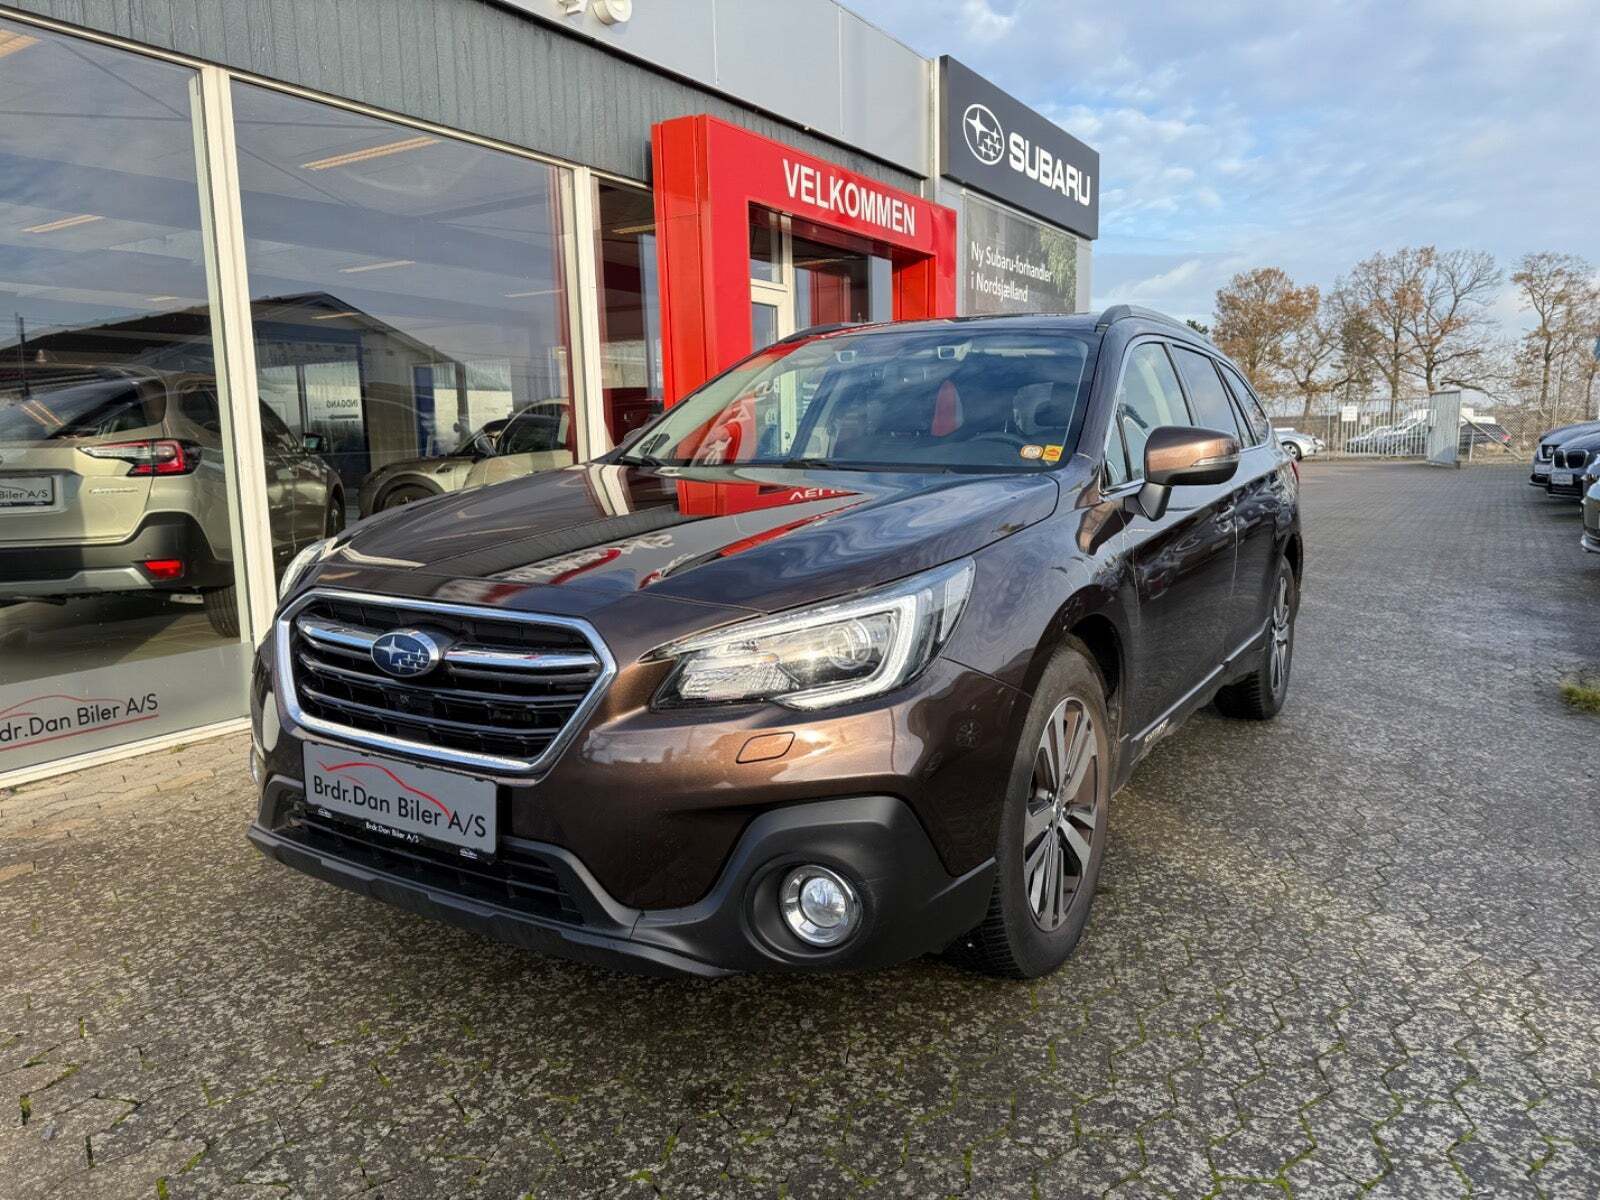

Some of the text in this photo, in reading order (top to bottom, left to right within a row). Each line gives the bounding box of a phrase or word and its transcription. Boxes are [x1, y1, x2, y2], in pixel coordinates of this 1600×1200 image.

[1009, 131, 1091, 206] SUBARU
[783, 158, 915, 237] VELKOMMEN
[971, 241, 1053, 282] Ny Subaru-forhandler
[976, 272, 1028, 302] Nordsjælland
[27, 489, 48, 498] A/S
[77, 704, 120, 726] Biler
[126, 693, 158, 716] A/S
[313, 775, 486, 838] Brdr.Dan Biler A/S
